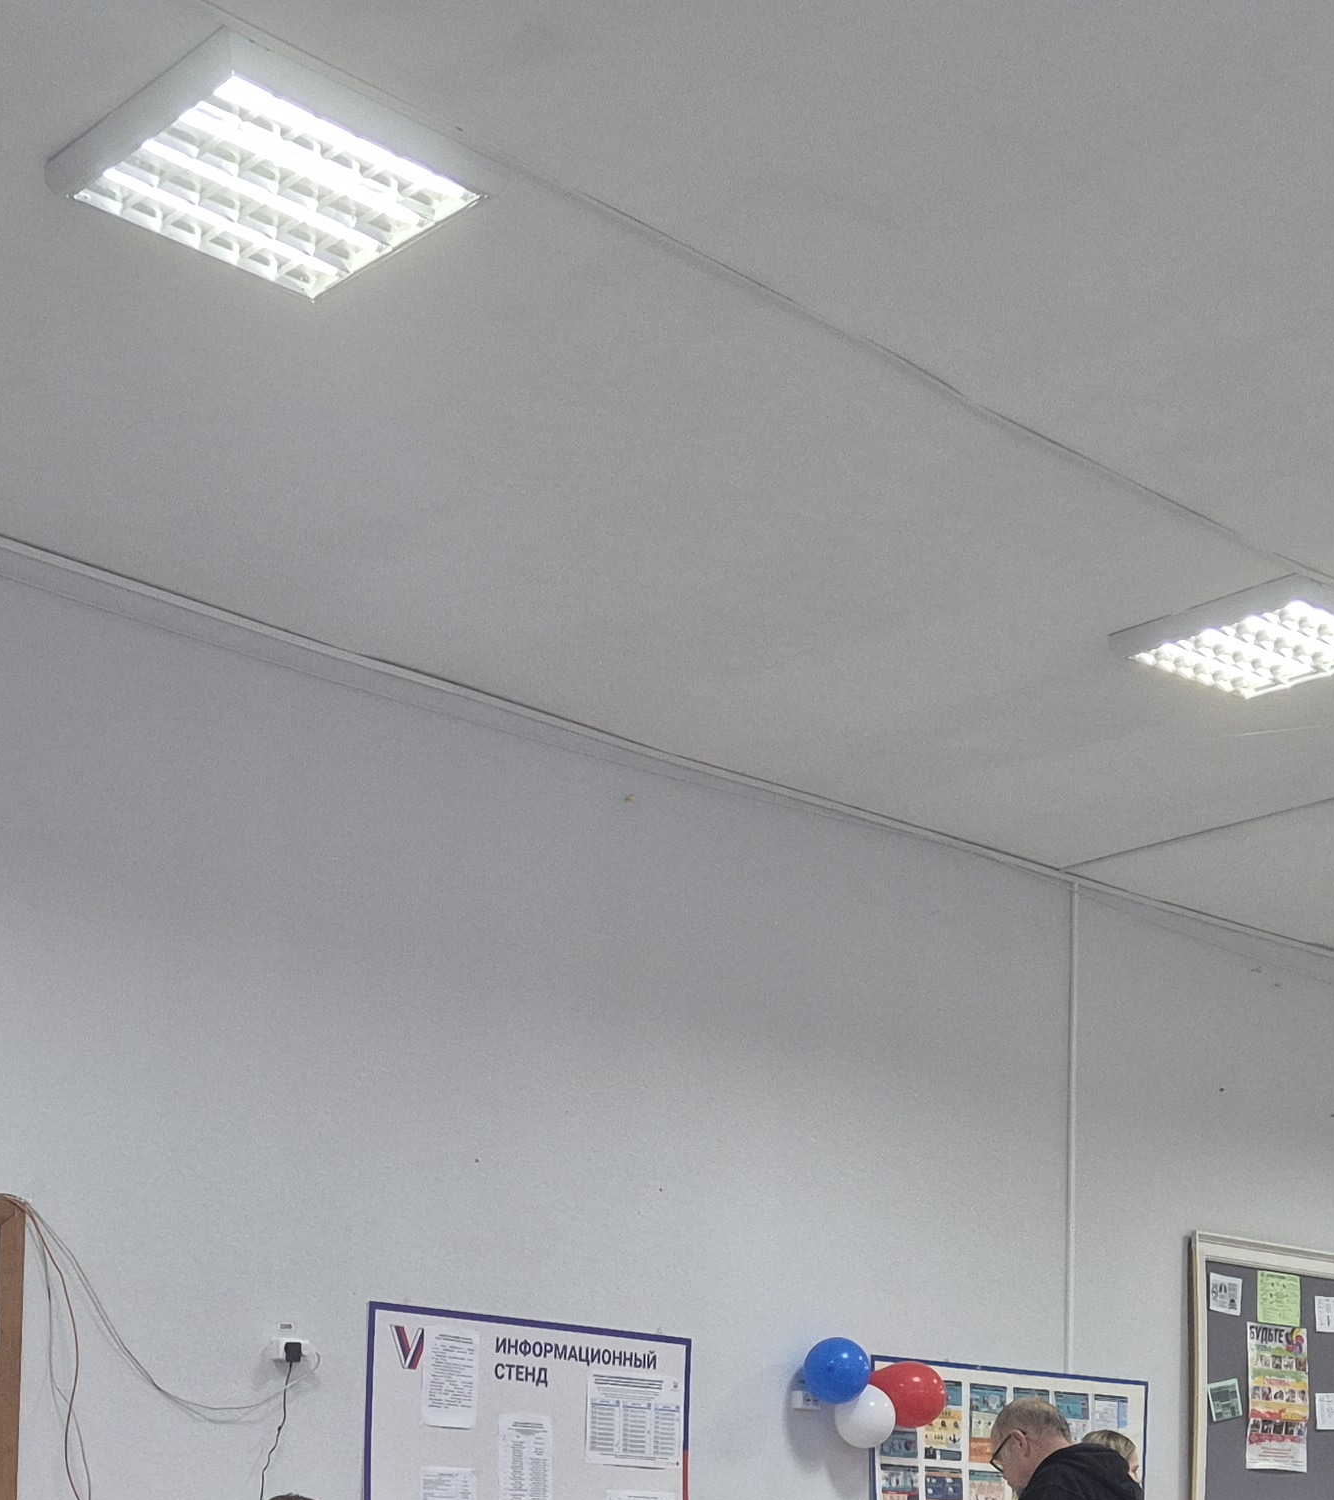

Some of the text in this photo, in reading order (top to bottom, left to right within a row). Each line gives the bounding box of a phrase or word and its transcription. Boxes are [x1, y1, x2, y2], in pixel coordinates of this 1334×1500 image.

[1249, 1325, 1285, 1344] БУДЬТЕ
[495, 1336, 657, 1370] ИНФОРМАЦИОННЫЙ
[494, 1363, 548, 1388] СТЕНД
